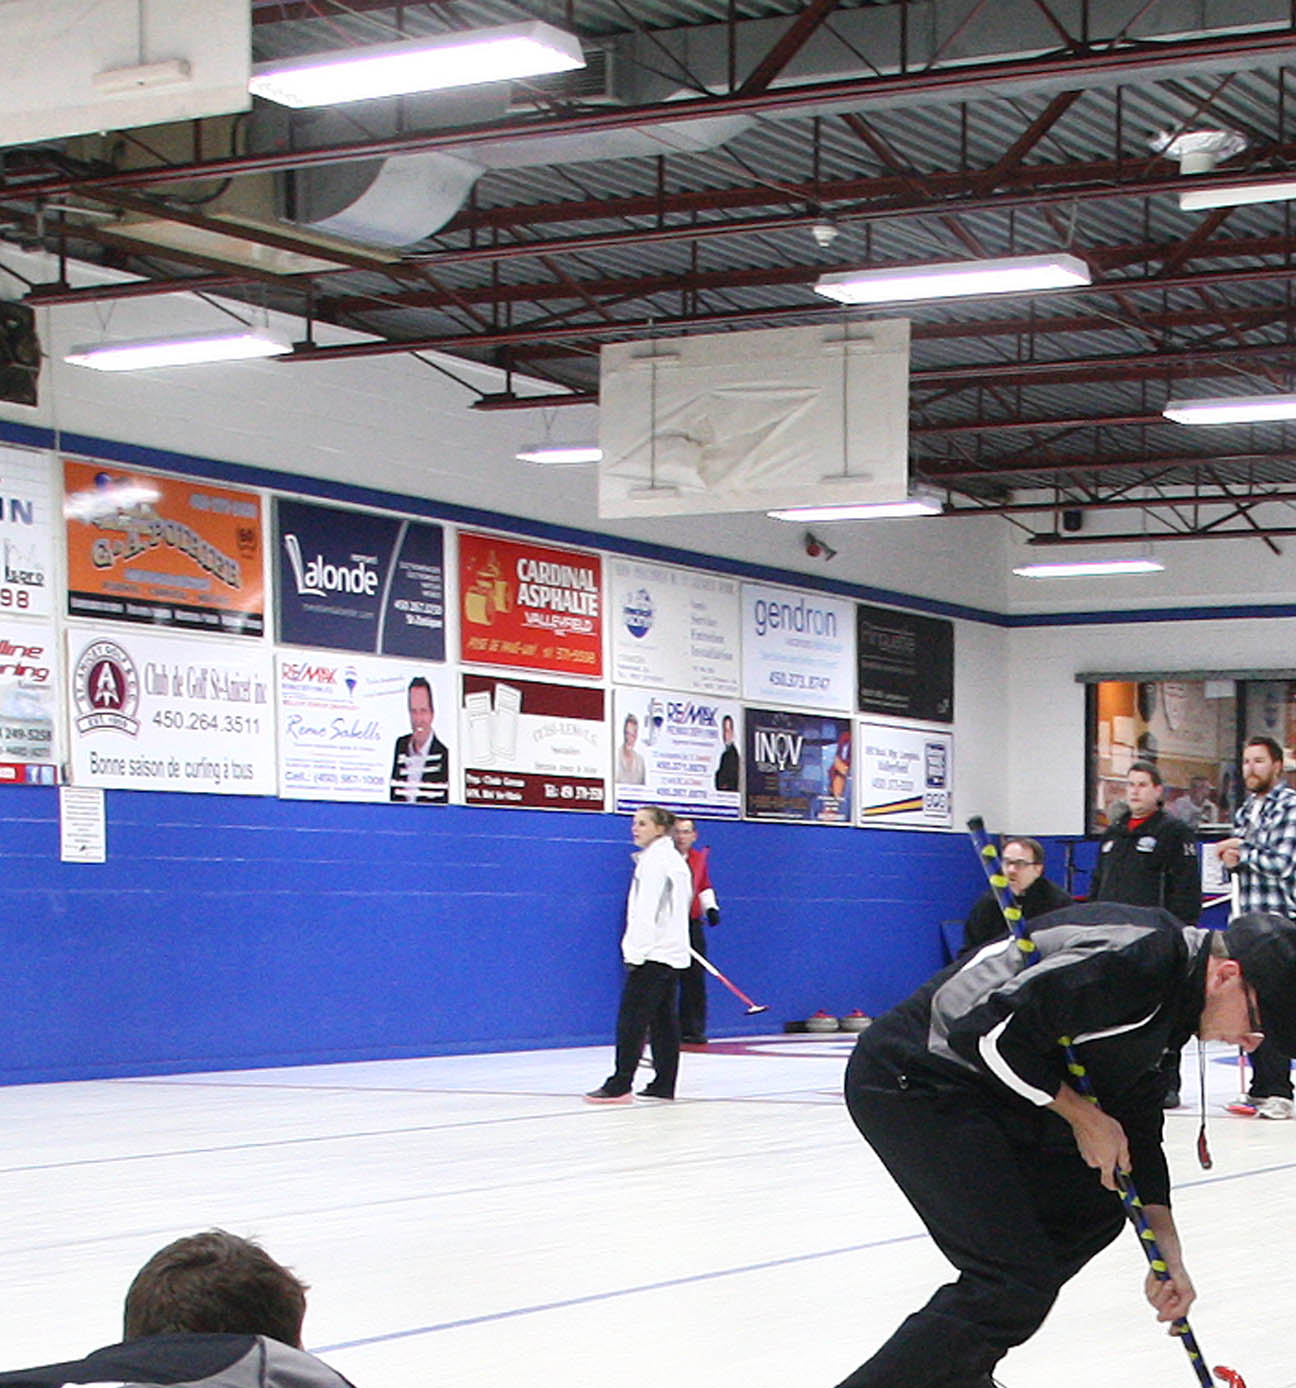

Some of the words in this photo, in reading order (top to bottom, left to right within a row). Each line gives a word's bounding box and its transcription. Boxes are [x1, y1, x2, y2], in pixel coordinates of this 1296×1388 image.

[284, 534, 379, 597] Lalonde
[517, 558, 598, 592] CARDINAL
[517, 583, 599, 617] ASPHALTE
[755, 598, 837, 637] gendron
[281, 662, 339, 685] RE/MAX
[152, 710, 260, 735] 450.264.3511
[667, 701, 719, 728] RE/MAX
[90, 751, 126, 776] Bonne
[129, 754, 165, 777] saison
[167, 755, 180, 778] de
